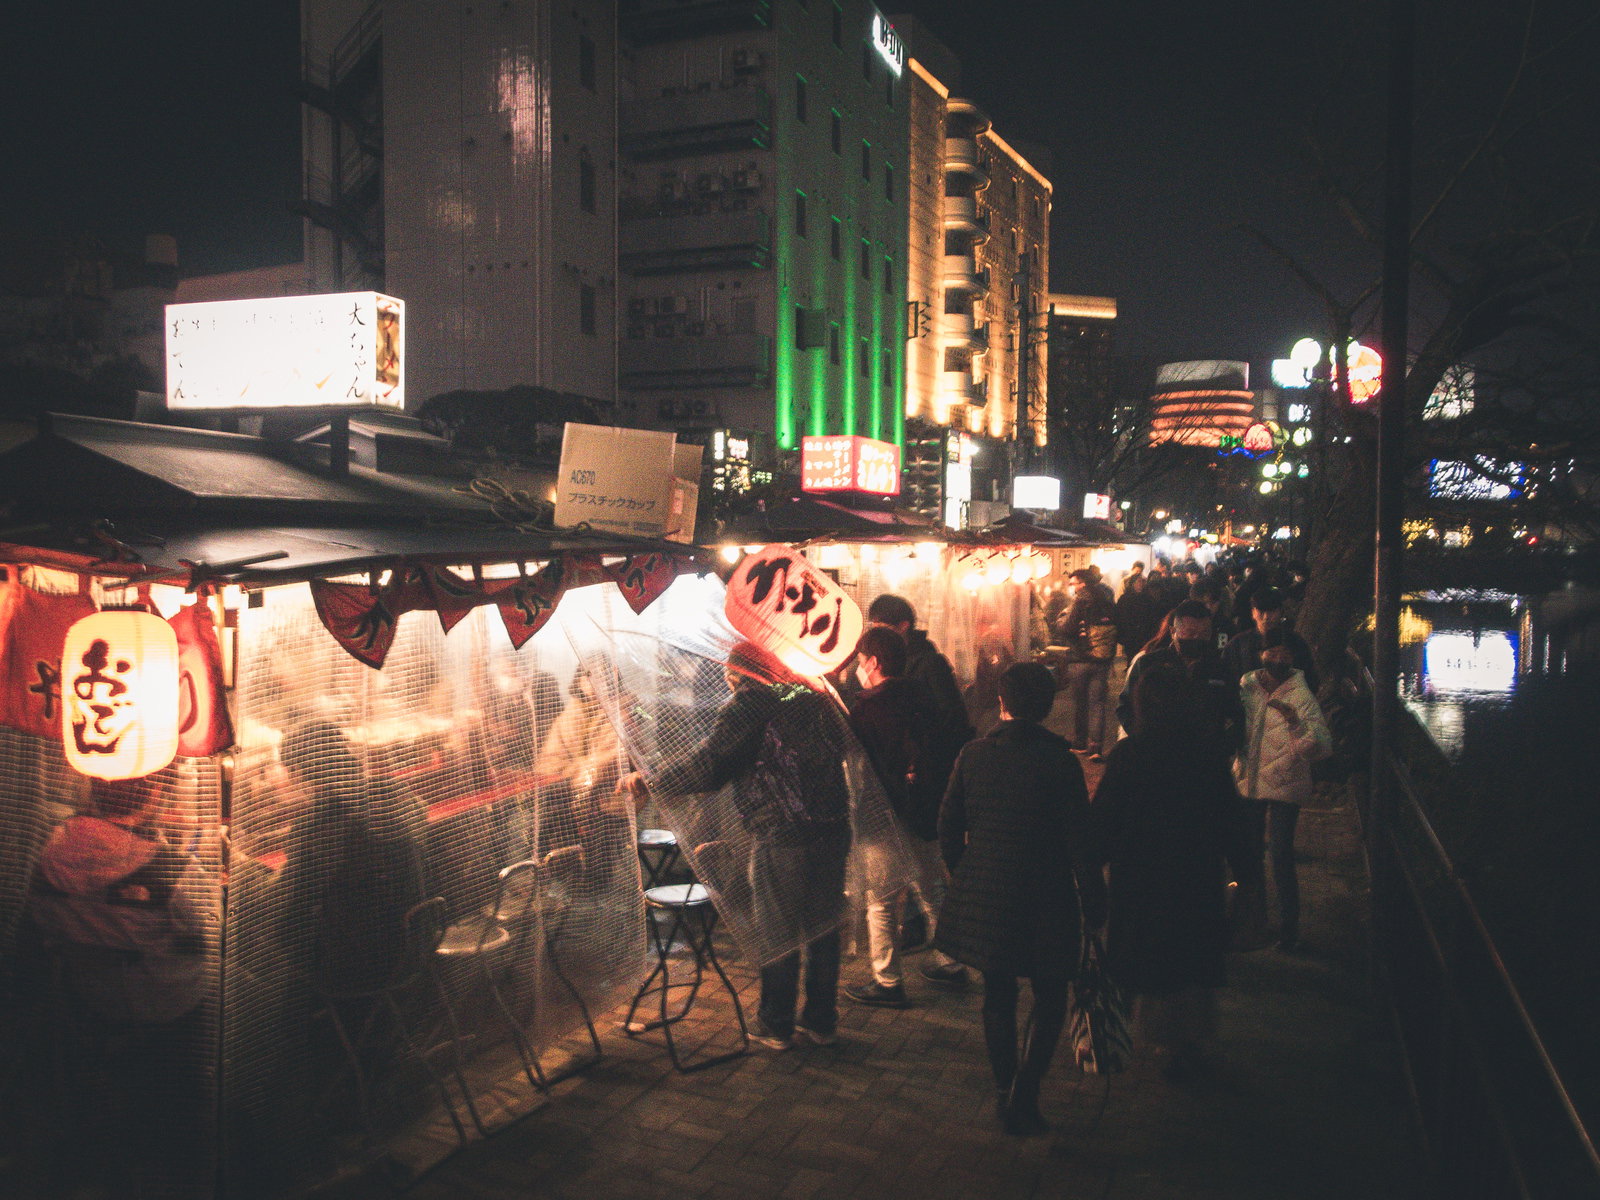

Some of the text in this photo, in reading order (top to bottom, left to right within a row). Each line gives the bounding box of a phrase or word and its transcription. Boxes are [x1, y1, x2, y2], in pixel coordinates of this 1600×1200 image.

[568, 493, 656, 511] プラスチックカップ
[74, 638, 133, 754] おでん
